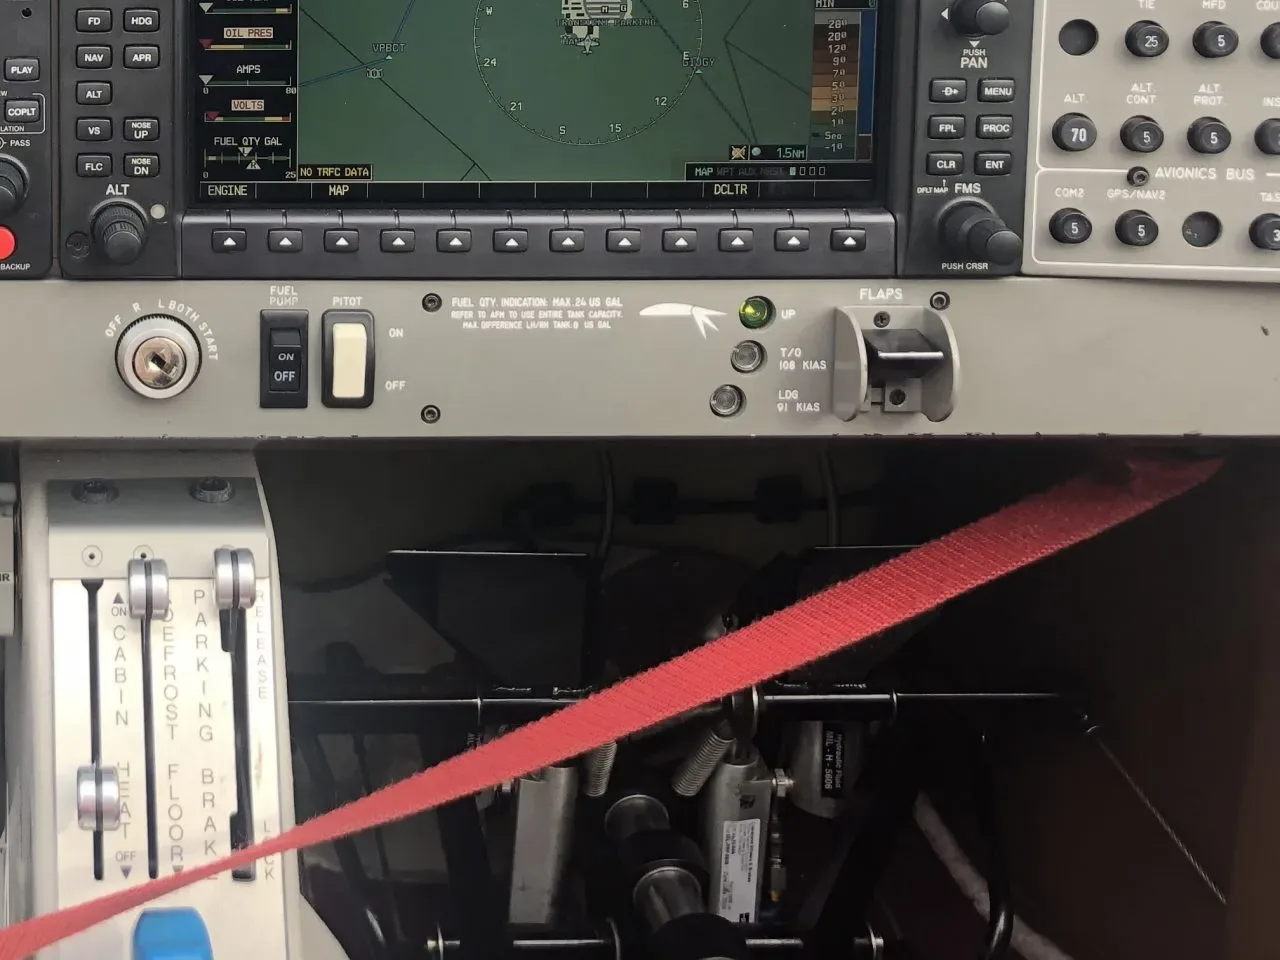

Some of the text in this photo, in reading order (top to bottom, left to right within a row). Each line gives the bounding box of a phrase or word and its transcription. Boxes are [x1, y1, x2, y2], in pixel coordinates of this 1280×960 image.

[132, 54, 151, 62] APR
[960, 58, 988, 68] PAN
[11, 66, 33, 75] PLAY
[86, 90, 102, 98] ALT
[8, 108, 36, 116] COPLT
[85, 162, 103, 171] FLC
[1155, 168, 1255, 180] AVIONICS BUS
[106, 184, 129, 195] ALT
[208, 186, 247, 195] ENGINE
[714, 185, 747, 195] DCLTR
[270, 286, 298, 296] FUEL
[860, 288, 902, 300] FLAPS
[270, 296, 298, 305] PUMP
[333, 296, 362, 306] PITOT
[199, 322, 218, 361] START
[274, 371, 295, 381] OFF
[194, 590, 214, 741] PARKING
[113, 625, 128, 726] CABIN
